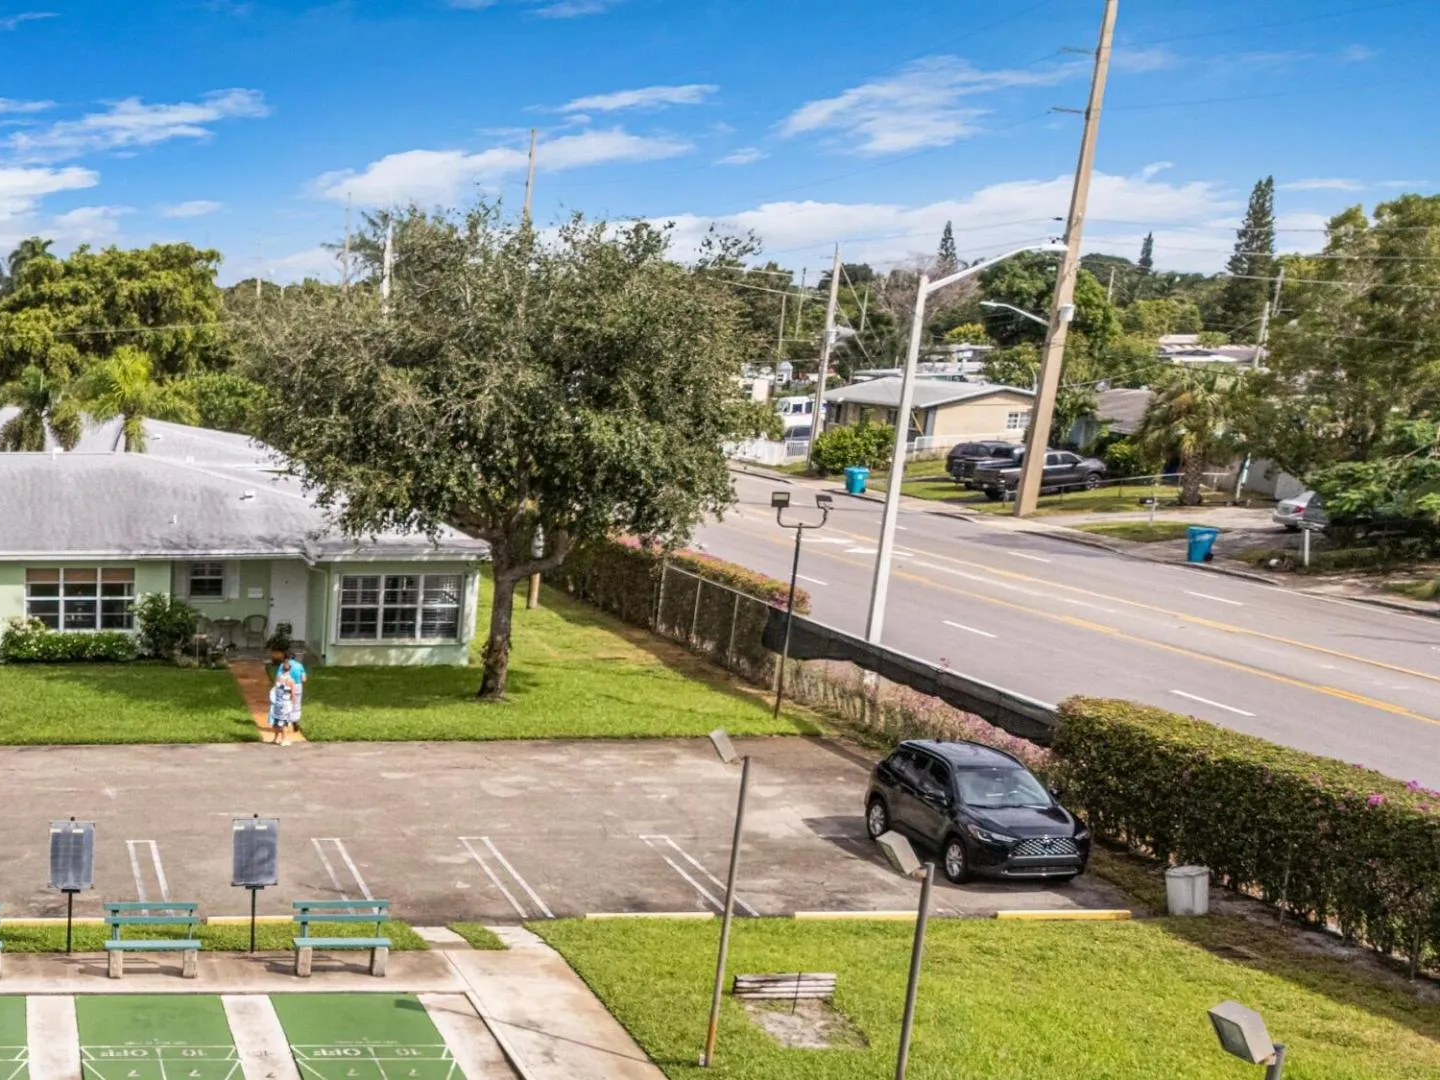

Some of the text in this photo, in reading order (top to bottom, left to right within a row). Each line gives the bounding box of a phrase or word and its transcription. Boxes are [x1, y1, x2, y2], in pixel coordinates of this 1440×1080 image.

[182, 1049, 207, 1057] 10
[127, 1069, 140, 1078] 7
[188, 1069, 202, 1078] 7
[347, 1068, 359, 1077] 7
[409, 1068, 421, 1077] 7
